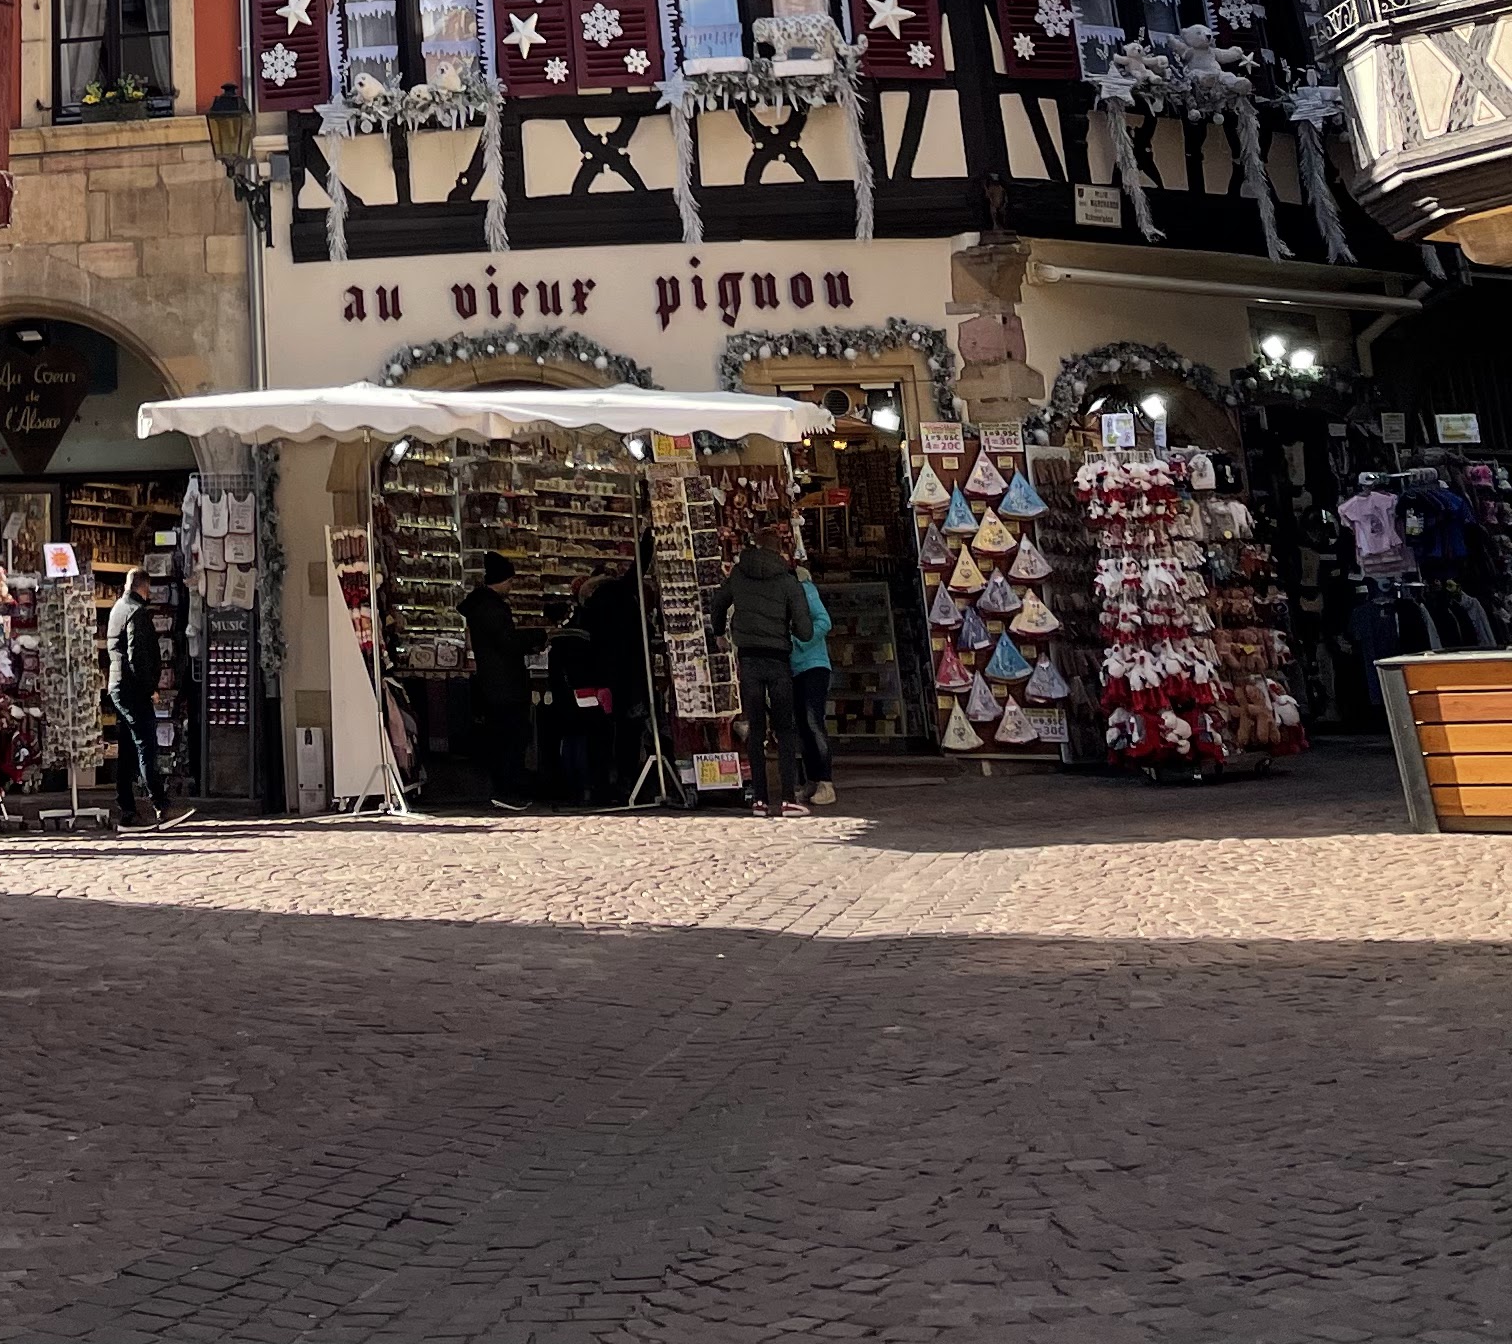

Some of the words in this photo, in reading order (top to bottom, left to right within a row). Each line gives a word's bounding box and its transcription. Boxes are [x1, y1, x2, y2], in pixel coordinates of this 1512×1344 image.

[344, 284, 403, 322] au
[451, 264, 596, 320] vieux
[655, 256, 854, 332] pignon
[26, 390, 40, 402] de
[211, 620, 246, 631] MUSIC
[696, 753, 735, 762] MAGNETS
